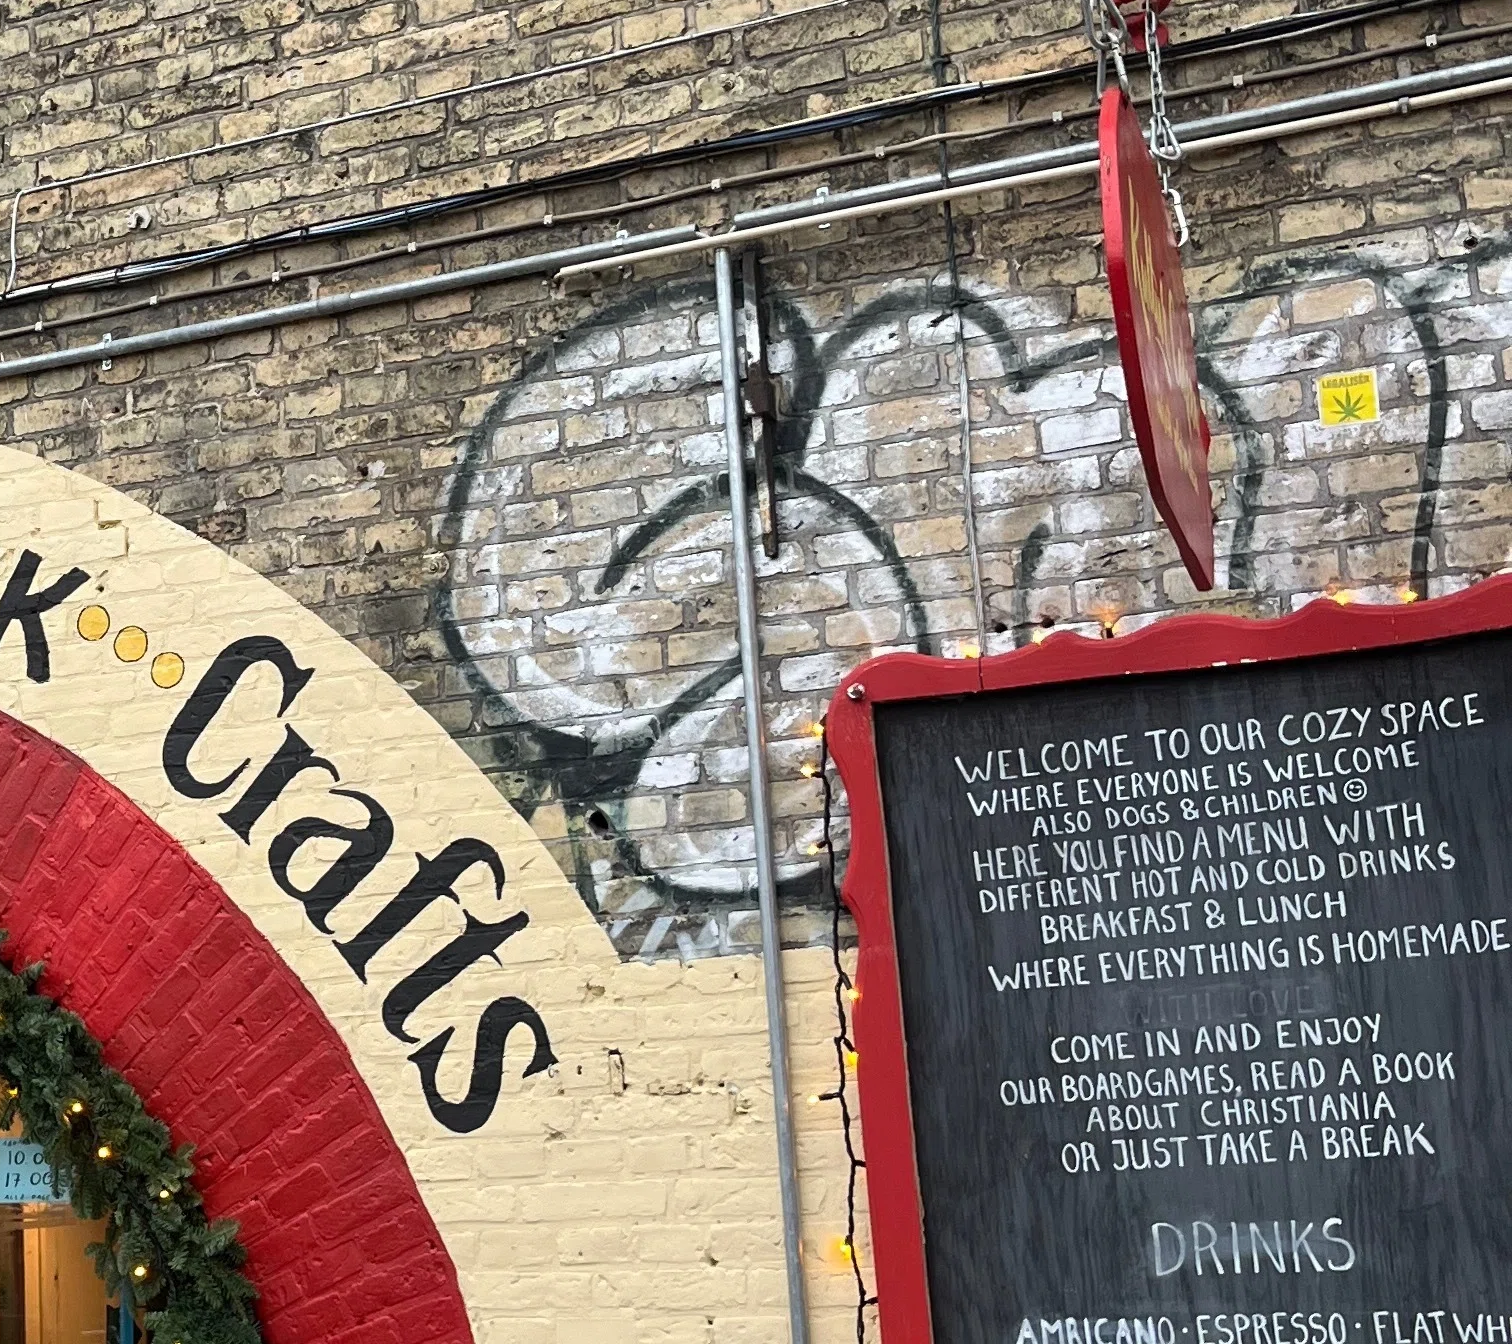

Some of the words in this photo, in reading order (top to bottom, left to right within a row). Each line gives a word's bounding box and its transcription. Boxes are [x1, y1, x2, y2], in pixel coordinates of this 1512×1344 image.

[955, 734, 1134, 783] WELCOME
[1145, 728, 1191, 761] TO
[1200, 719, 1267, 754] OUR
[1278, 707, 1372, 746] COZY
[1380, 693, 1484, 737] SPACE
[967, 779, 1068, 817] WHERE
[1077, 764, 1219, 804] EVERYONE
[1227, 762, 1252, 788] IS
[1263, 741, 1419, 785] WELCOME
[1032, 814, 1092, 837] ALSO
[1106, 804, 1170, 830] DOGS
[1204, 783, 1337, 819] CHILDREN
[973, 846, 1048, 882] HERE
[1052, 841, 1109, 875] YOU
[1112, 832, 1185, 868] FIND
[1191, 831, 1213, 862] A
[1216, 818, 1308, 859] MENU
[1322, 802, 1425, 847] WITH
[161, 634, 560, 1134] Crafts
[979, 873, 1121, 914] DIFFERENT
[1131, 868, 1181, 902] HOT
[1190, 862, 1249, 895] AND
[1256, 858, 1325, 888] COLD
[1338, 843, 1456, 880] DRINKS
[1040, 903, 1192, 945] BREAKFAST
[1204, 902, 1226, 926] &
[1239, 891, 1347, 924] LUNCH
[989, 960, 1089, 993] WHERE
[1101, 933, 1290, 984] EVERYTHING
[1299, 935, 1324, 966] IS
[1334, 919, 1511, 963] HOMEMADE
[1051, 1034, 1135, 1064] COME
[1145, 1030, 1179, 1058] IN
[1195, 1023, 1260, 1053] AND
[1277, 1014, 1381, 1048] ENJOY
[1000, 1078, 1055, 1106] OUR
[1251, 1057, 1325, 1093] READ
[1339, 1058, 1361, 1085] A
[1374, 1052, 1456, 1084] BOOK
[1086, 1101, 1179, 1133] ABOUT
[1201, 1091, 1395, 1128] CHRISTIANIA
[1061, 1141, 1100, 1173] OR
[1113, 1137, 1188, 1170] JUST
[1198, 1132, 1274, 1165] TAKE
[1289, 1132, 1308, 1161] A
[1323, 1122, 1435, 1160] BREAK
[1150, 1217, 1356, 1277] DRINKS
[1375, 1310, 1445, 1344] FLAT
